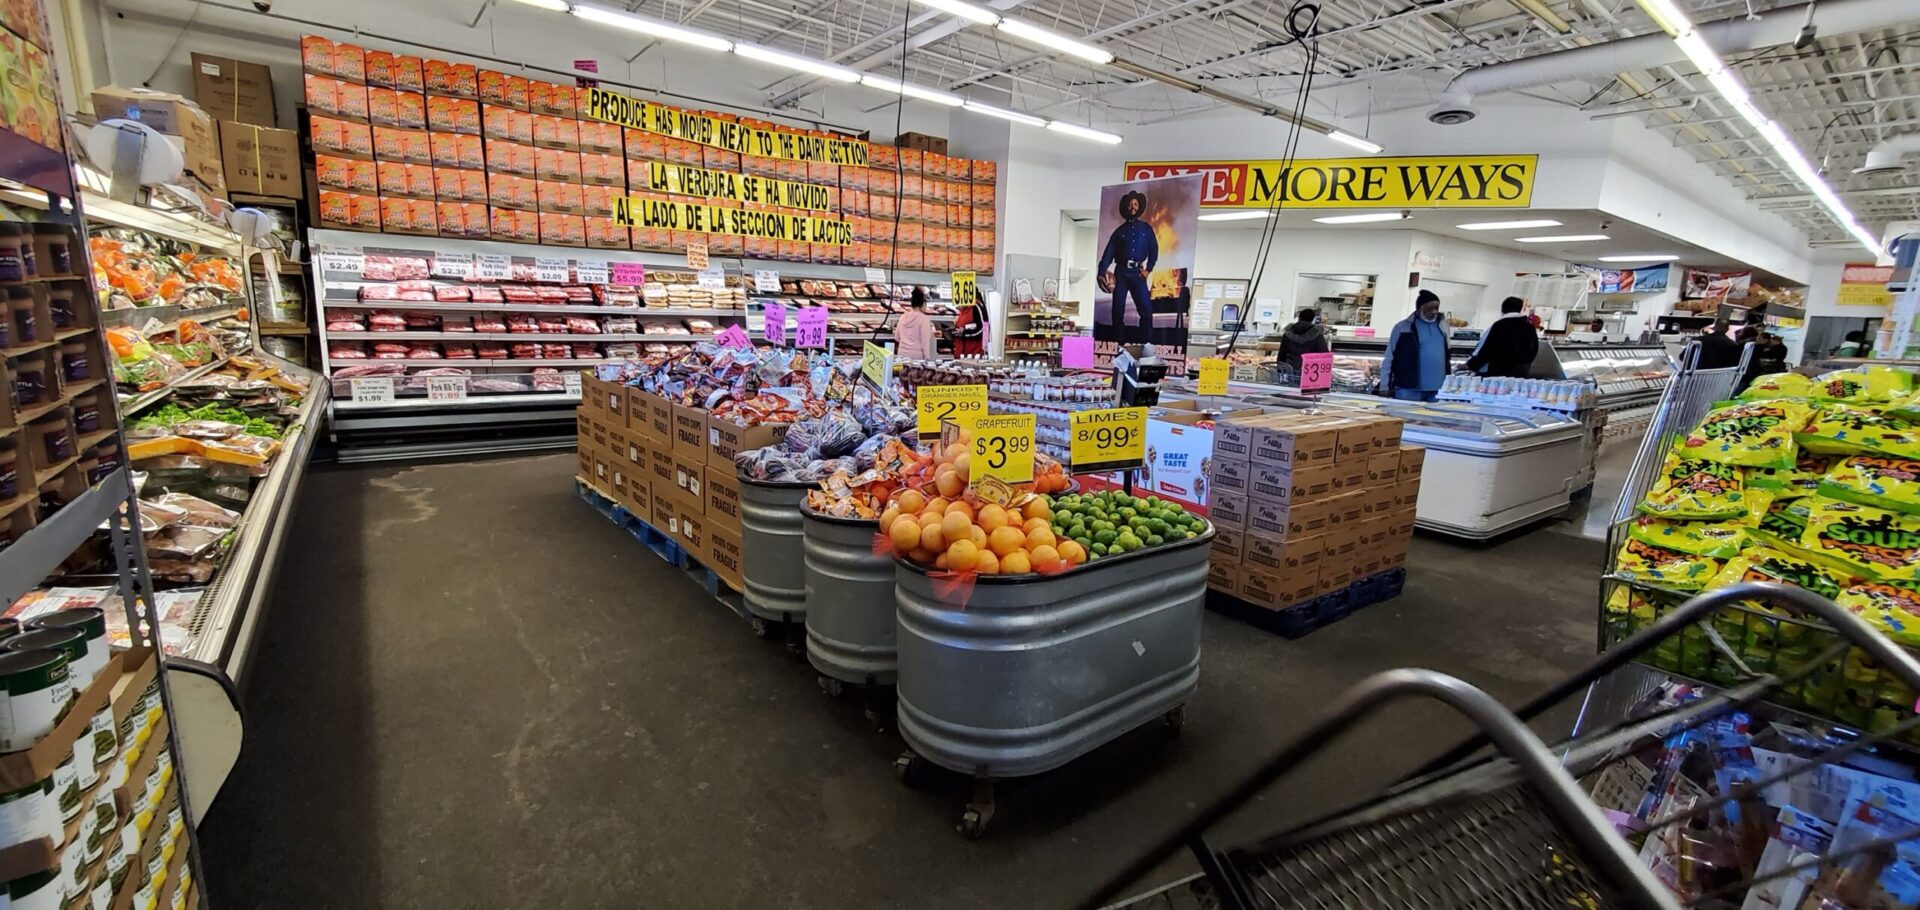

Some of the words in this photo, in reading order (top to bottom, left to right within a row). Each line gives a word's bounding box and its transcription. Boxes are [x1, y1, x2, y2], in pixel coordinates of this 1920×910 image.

[591, 89, 646, 128] PRODUCE
[655, 108, 672, 134] HAS
[680, 114, 712, 144] MOVED
[720, 122, 750, 153] NEXT
[756, 132, 772, 156] TO
[778, 134, 793, 158] THE
[798, 136, 824, 162] DAIRY
[829, 140, 868, 164] SECTION
[652, 163, 668, 190] LA
[678, 167, 736, 200] VERDURA
[744, 177, 758, 202] SE
[766, 180, 780, 206] HA
[787, 183, 828, 210] MOVIDO
[1249, 166, 1387, 201] MORE
[1398, 164, 1525, 201] WAYS
[618, 198, 634, 225] AL
[643, 200, 677, 228] LADO
[686, 205, 702, 231] DE
[710, 208, 725, 232] LA
[732, 210, 785, 238] SECCION
[792, 218, 806, 240] DE
[812, 219, 851, 246] LACTOS
[330, 262, 358, 270] $2.49
[954, 281, 974, 304] 3.69
[766, 324, 772, 340] 3
[800, 329, 806, 345] 3
[432, 384, 442, 392] Pork
[444, 384, 452, 392] Rib
[453, 384, 464, 392] Tips
[976, 418, 1032, 429] GRAPEFRUIT
[1076, 411, 1139, 424] LIMES
[678, 430, 700, 448] FRAGILE
[725, 432, 738, 445] CHIPS
[1227, 432, 1240, 441] Nilla
[1268, 438, 1282, 448] Nilla
[654, 463, 672, 480] FRAGILE
[1224, 467, 1238, 476] Nilla
[1265, 474, 1279, 484] Nilla
[712, 496, 736, 518] FRAGILE
[1222, 500, 1235, 510] Nilla
[1263, 511, 1277, 520] Nilla
[1826, 523, 1920, 548] SOUR
[1260, 545, 1272, 555] Nilla
[714, 548, 737, 572] FRAGILE
[1254, 580, 1267, 590] Nilla
